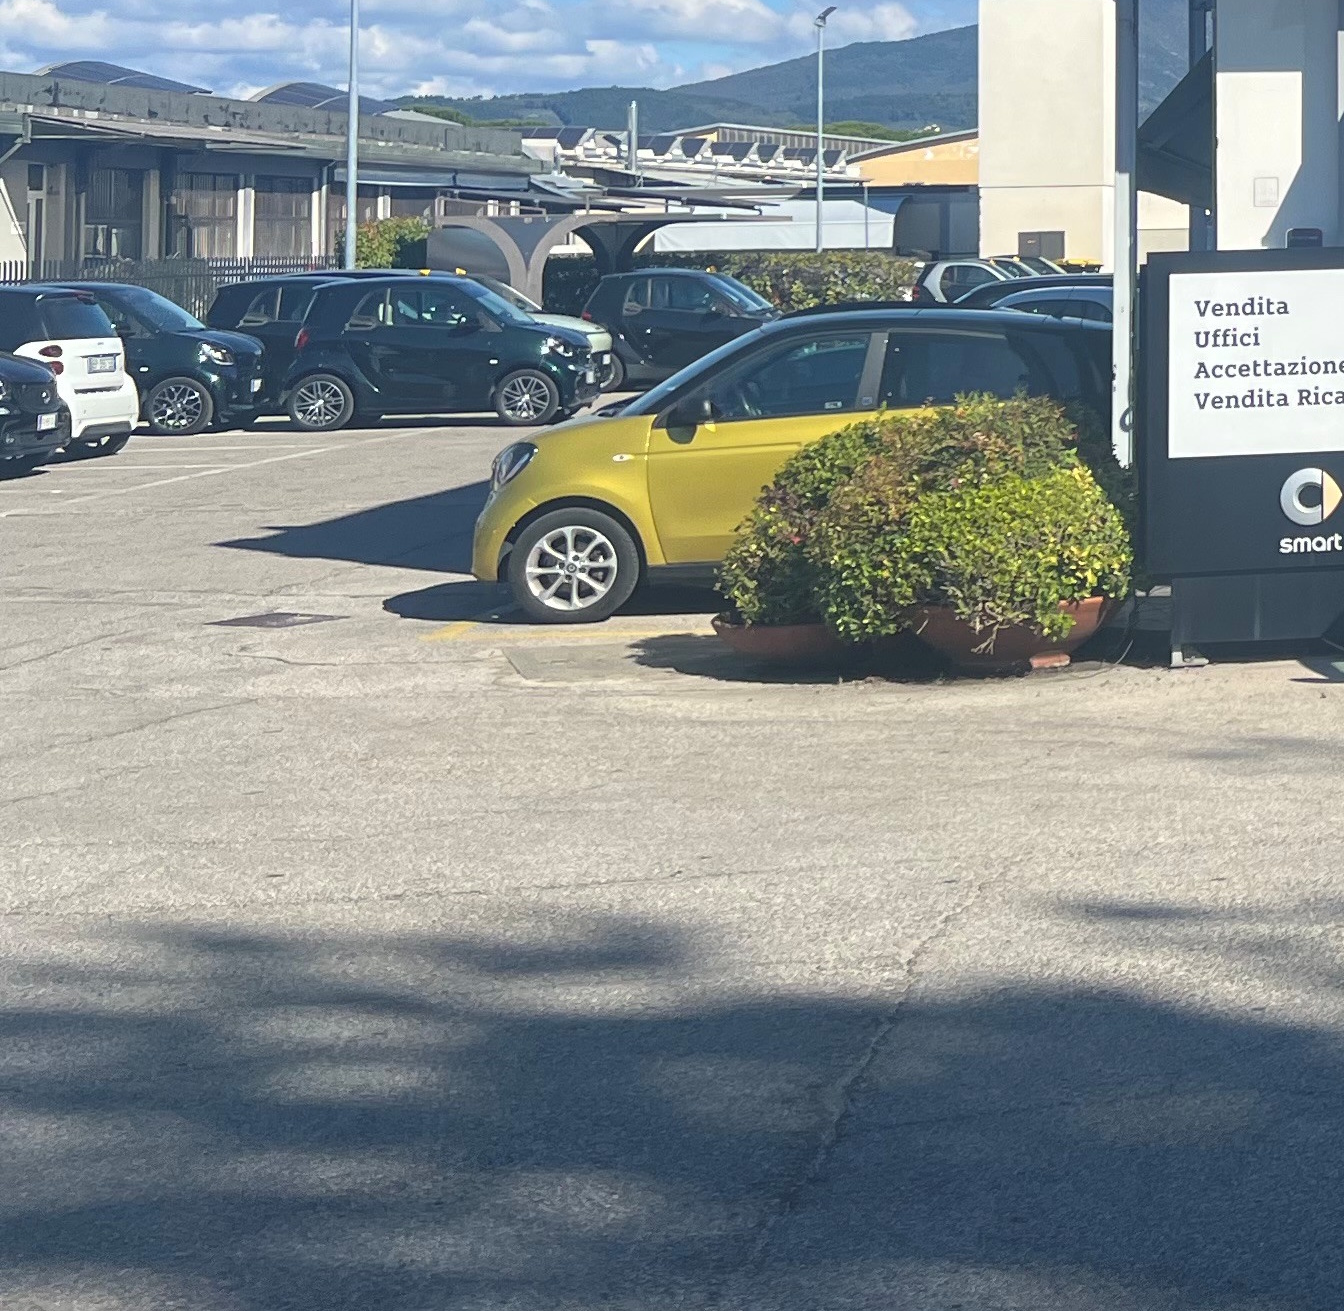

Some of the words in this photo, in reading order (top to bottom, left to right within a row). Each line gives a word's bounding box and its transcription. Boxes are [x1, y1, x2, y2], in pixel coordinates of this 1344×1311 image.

[1194, 296, 1290, 317] Vendita
[1194, 327, 1261, 348] Uffici
[1194, 388, 1290, 410] Vendita
[1279, 532, 1343, 554] smart
